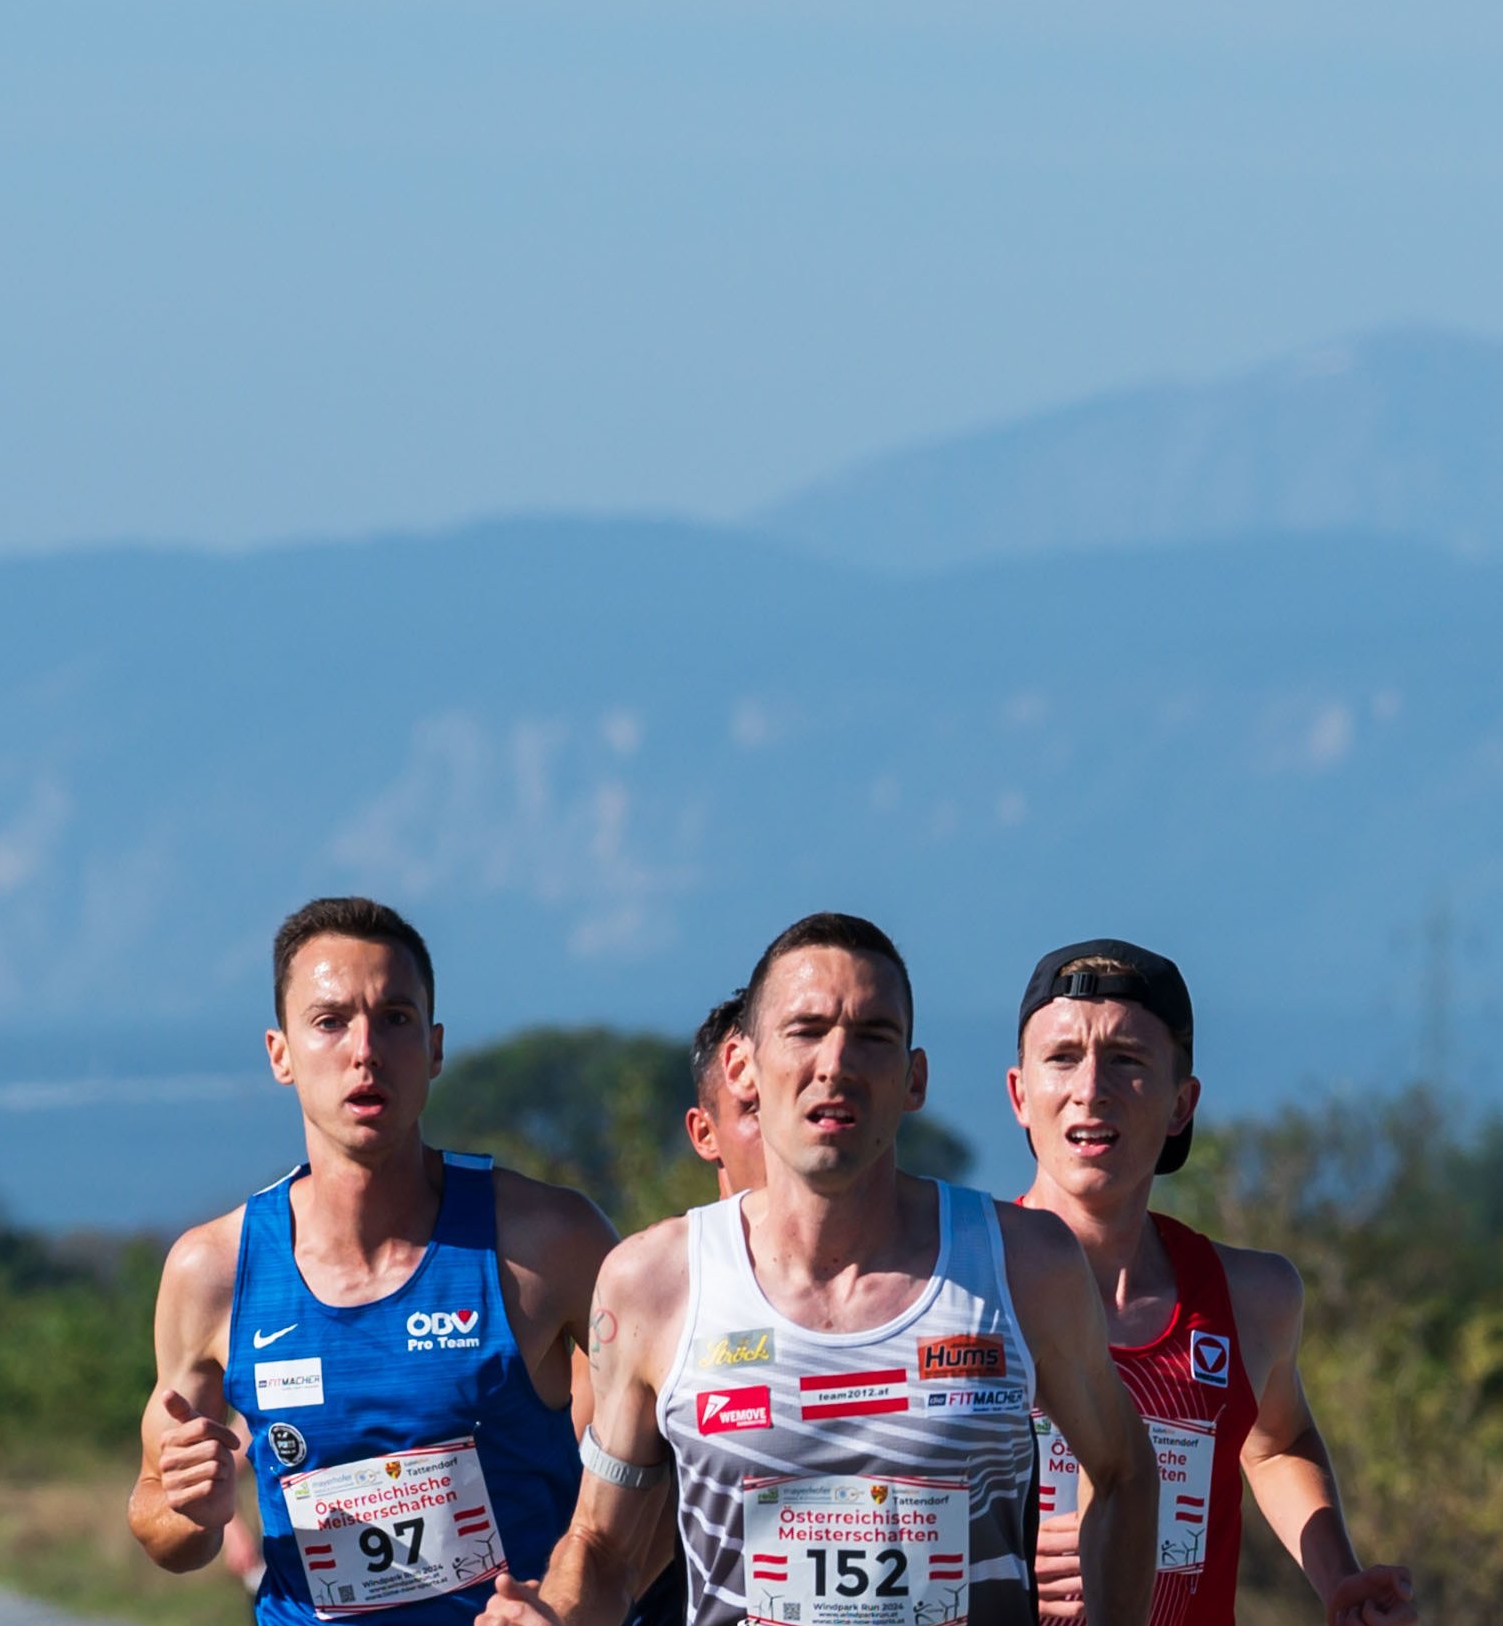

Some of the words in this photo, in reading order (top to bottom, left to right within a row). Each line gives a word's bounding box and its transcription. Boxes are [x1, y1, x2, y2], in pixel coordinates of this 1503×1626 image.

[407, 1338, 434, 1352] Pro
[437, 1336, 481, 1350] Team
[924, 1345, 999, 1369] Hums
[818, 1388, 889, 1402] team2012.at
[949, 1389, 1024, 1406] FITMACHER
[719, 1407, 767, 1424] WEMOVE
[1152, 1435, 1200, 1448] Tattendorf
[406, 1457, 459, 1478] Tattendorf
[314, 1476, 453, 1516] Österreichische
[893, 1494, 951, 1507] Tattendorf
[317, 1490, 459, 1532] Meisterschaften
[780, 1505, 938, 1526] Österreichische
[778, 1527, 940, 1543] Meisterschaften
[358, 1516, 426, 1574] 97
[805, 1548, 910, 1598] 152
[813, 1602, 859, 1612] Windpark
[861, 1602, 880, 1611] Run
[881, 1602, 905, 1611] 2024
